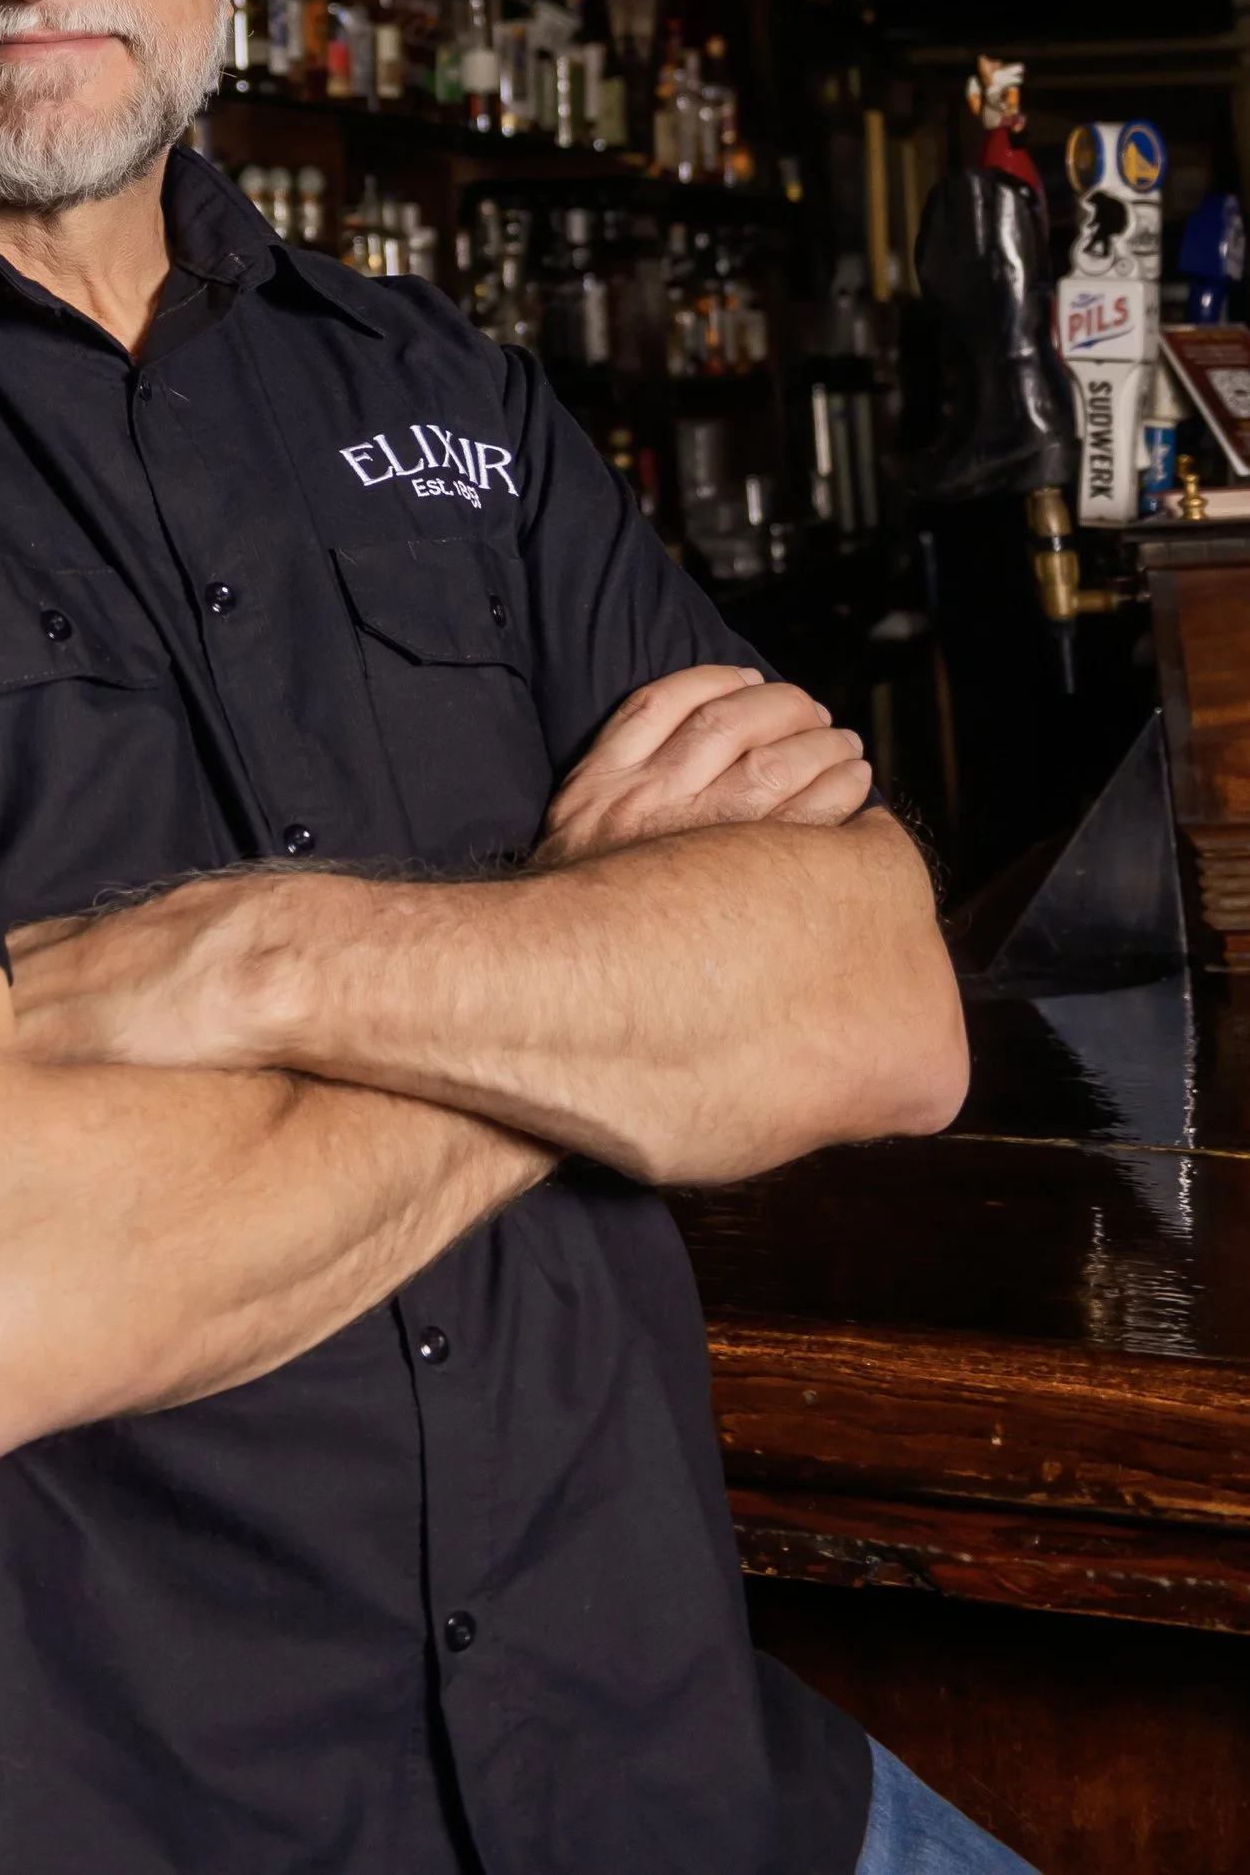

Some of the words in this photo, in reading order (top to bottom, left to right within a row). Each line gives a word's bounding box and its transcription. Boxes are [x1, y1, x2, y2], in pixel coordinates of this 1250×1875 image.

[1068, 296, 1129, 343] PILS
[338, 424, 521, 498] ELIXIR
[1088, 380, 1114, 501] SUDWERK
